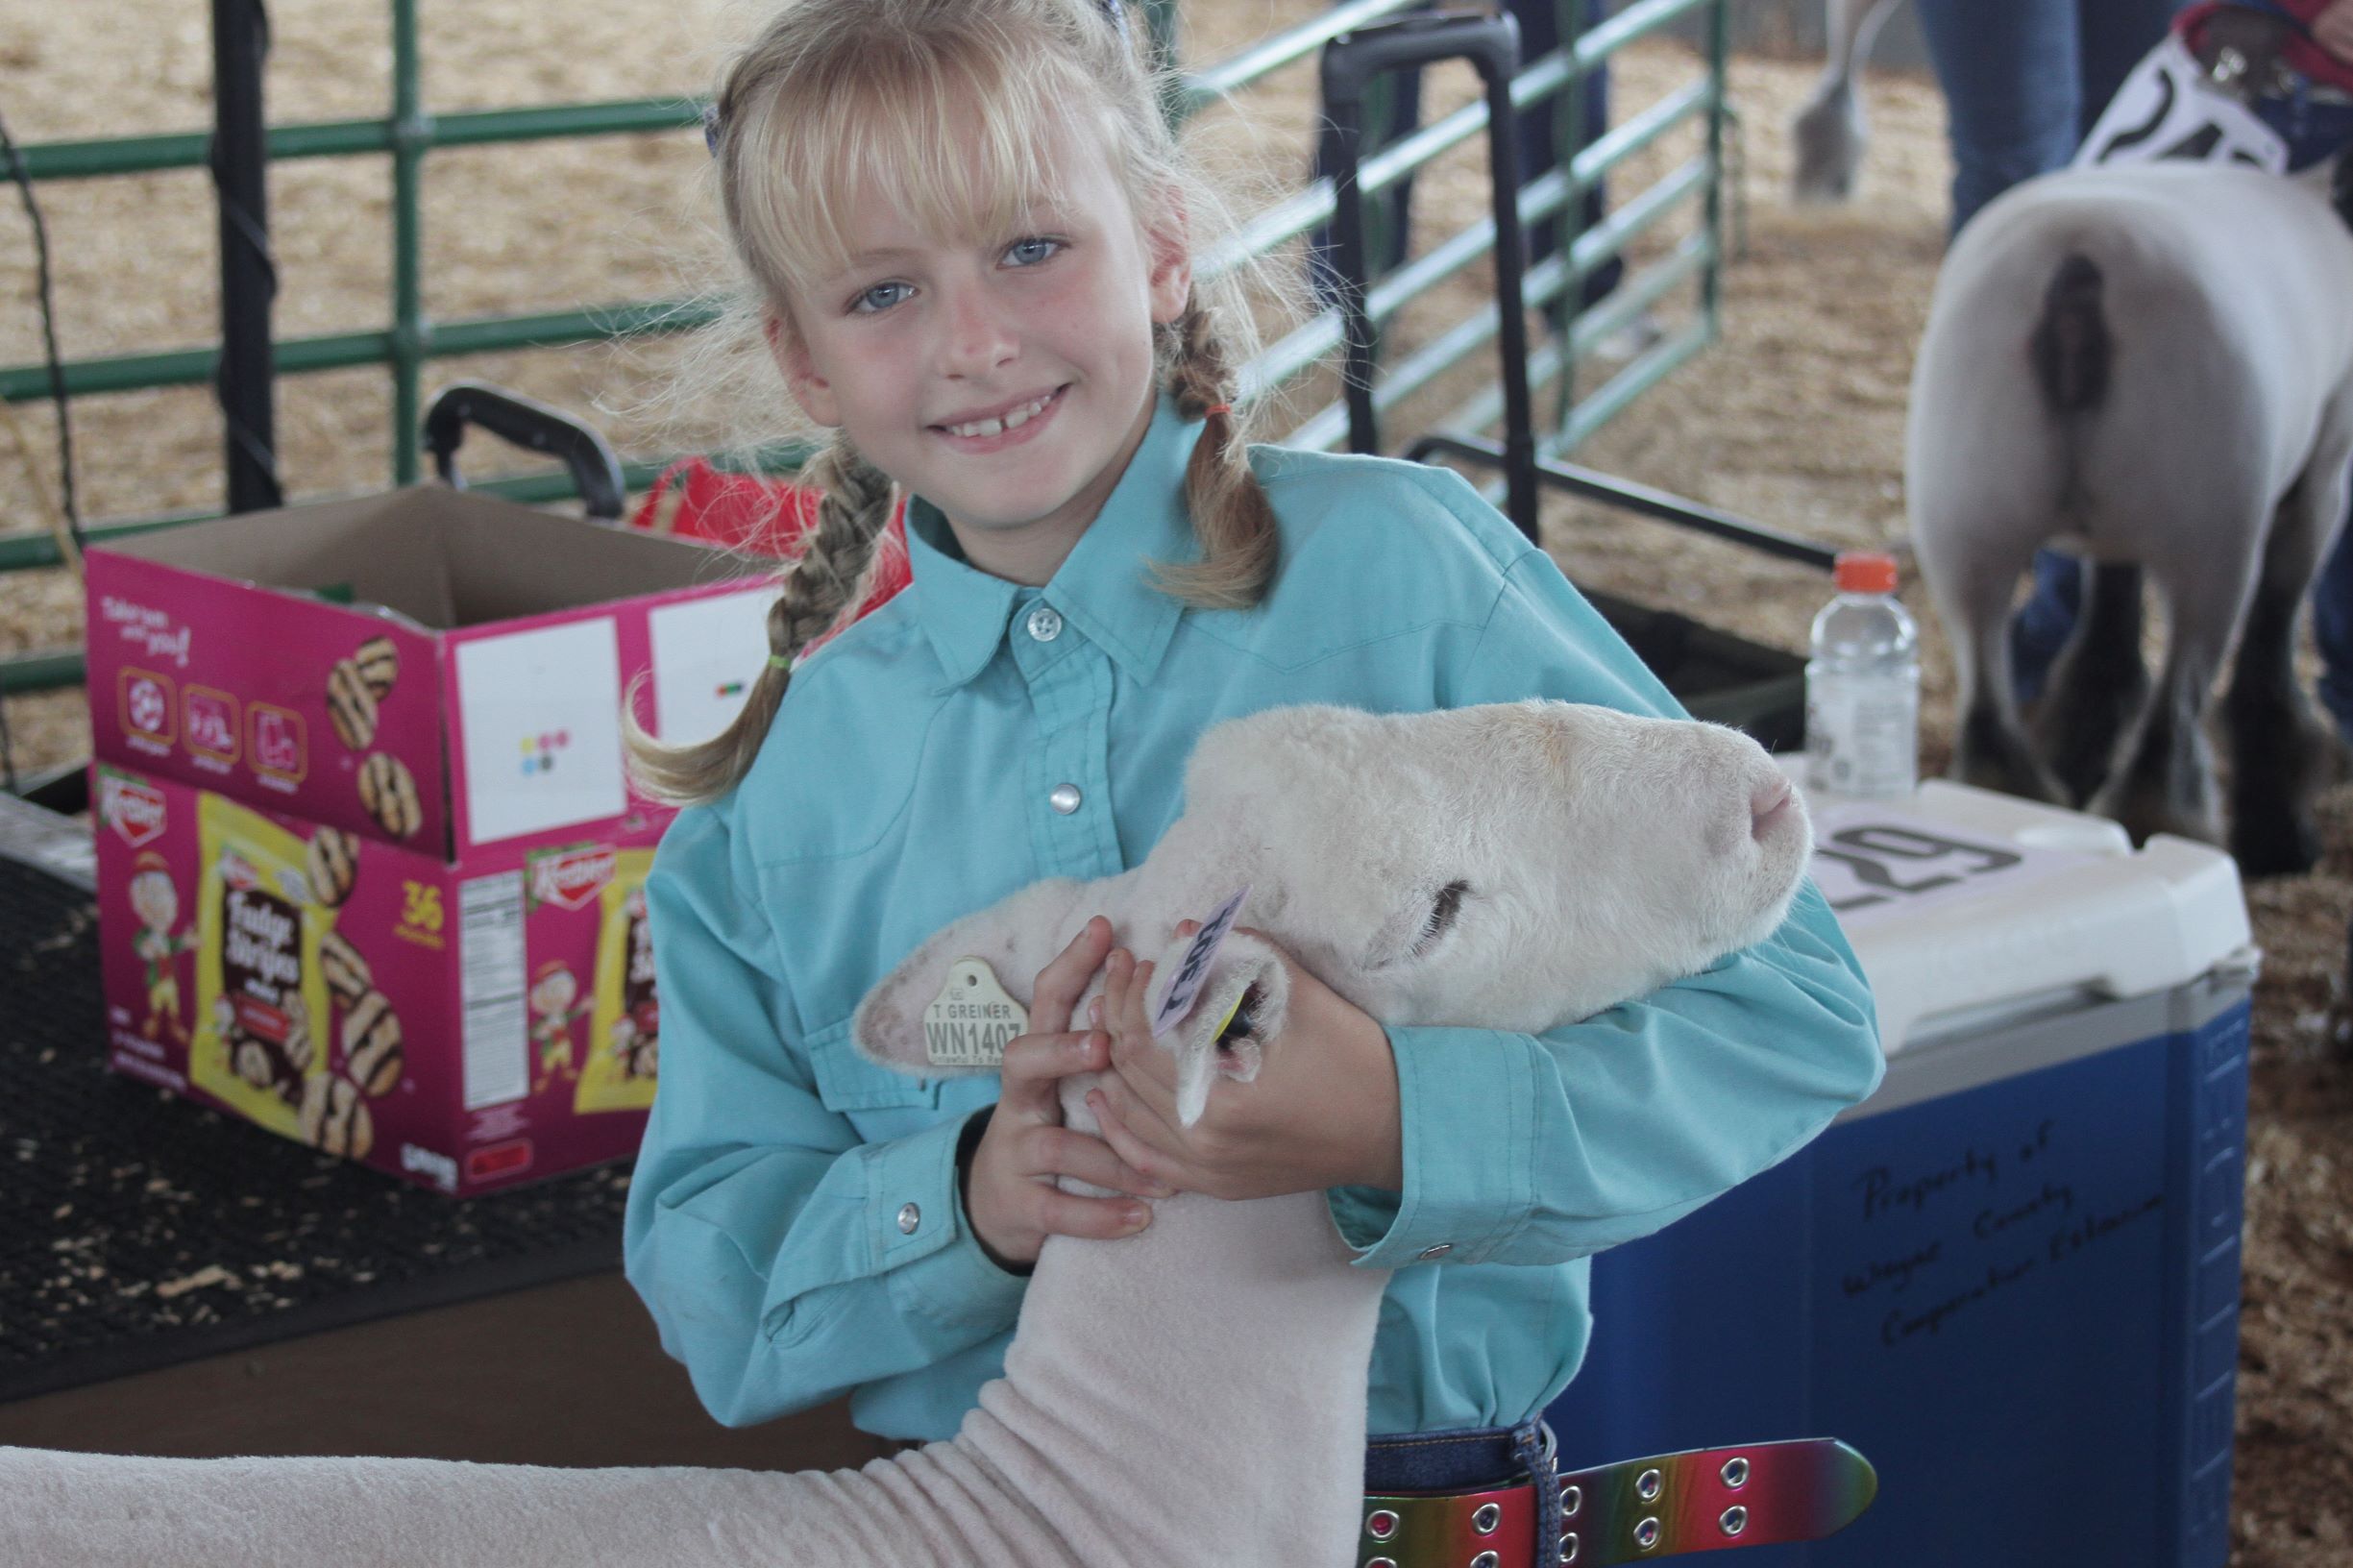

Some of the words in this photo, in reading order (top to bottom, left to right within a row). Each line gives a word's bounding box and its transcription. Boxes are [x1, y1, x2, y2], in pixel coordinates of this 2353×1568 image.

[402, 880, 443, 930] 36
[933, 1005, 941, 1018] T
[948, 1004, 1011, 1019] GREINER
